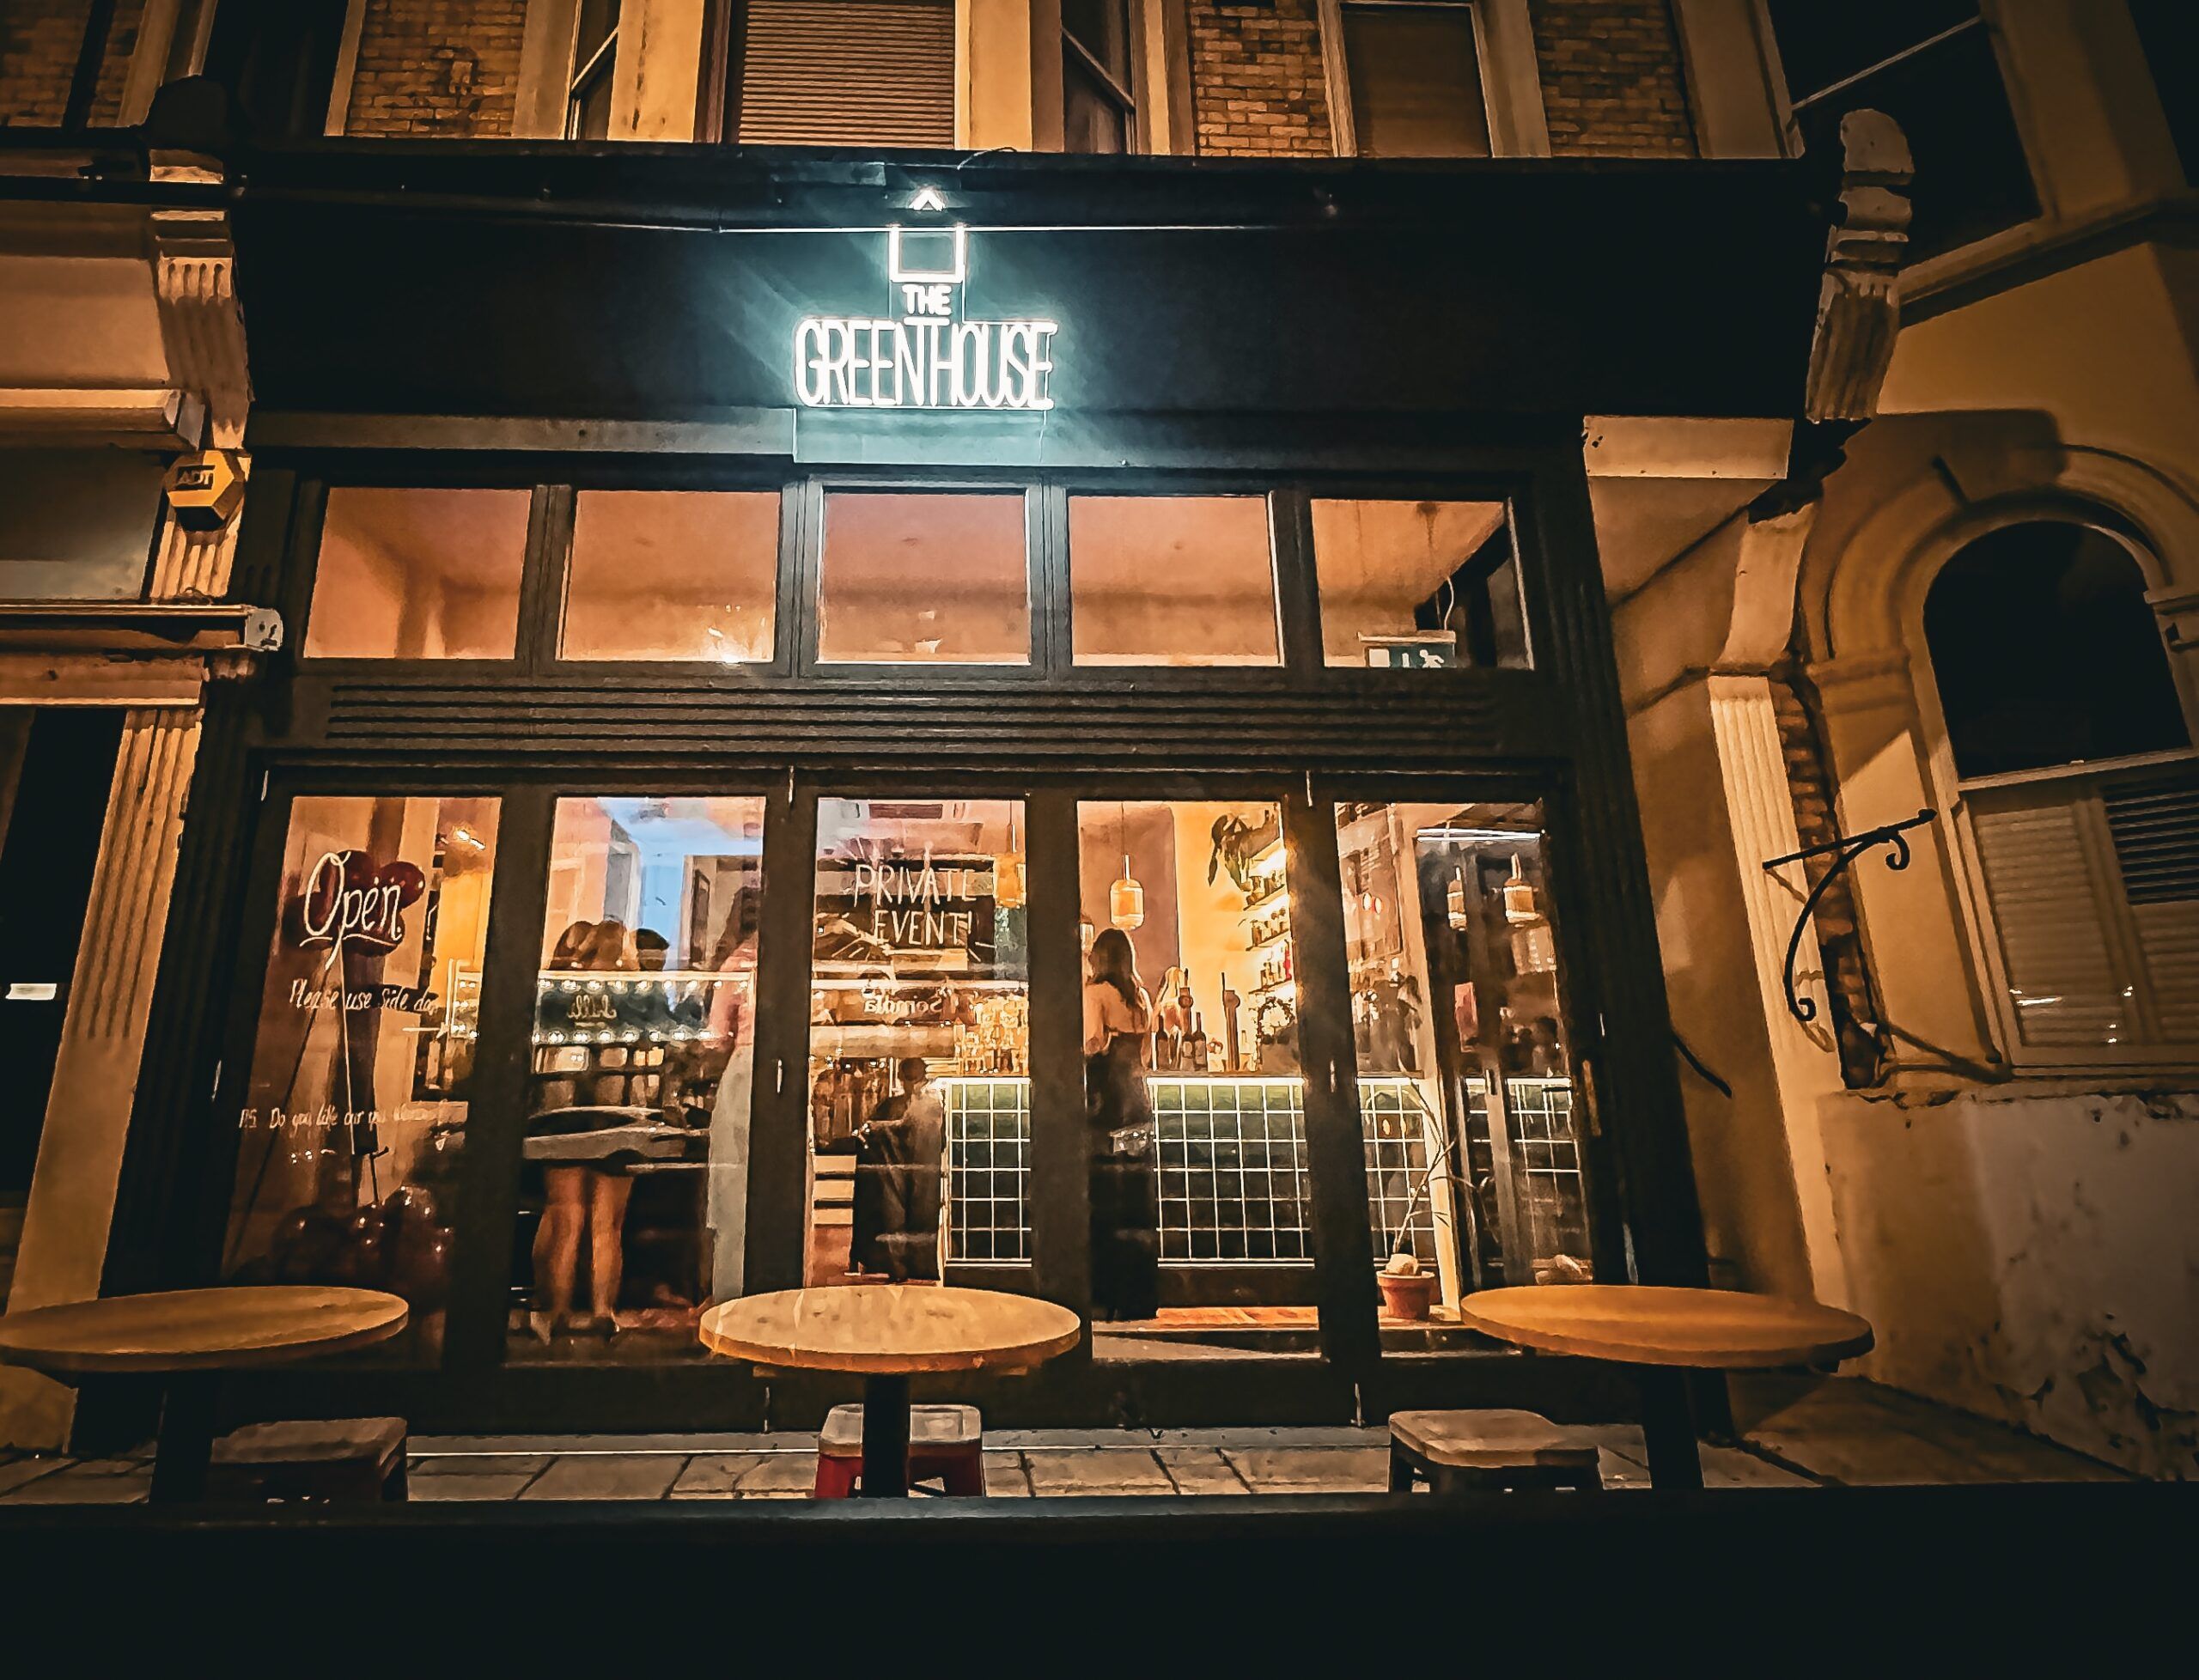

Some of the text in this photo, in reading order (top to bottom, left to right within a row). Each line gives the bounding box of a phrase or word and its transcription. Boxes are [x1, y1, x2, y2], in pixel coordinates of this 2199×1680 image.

[901, 284, 953, 315] THE
[795, 319, 1058, 411] GREENHOUSE
[177, 469, 215, 486] ADT
[853, 863, 978, 908] PRIVATE
[304, 850, 403, 971] Open
[873, 909, 972, 946] EVENT!
[289, 977, 340, 1010] Please
[345, 992, 373, 1011] use
[269, 1106, 286, 1129] Do
